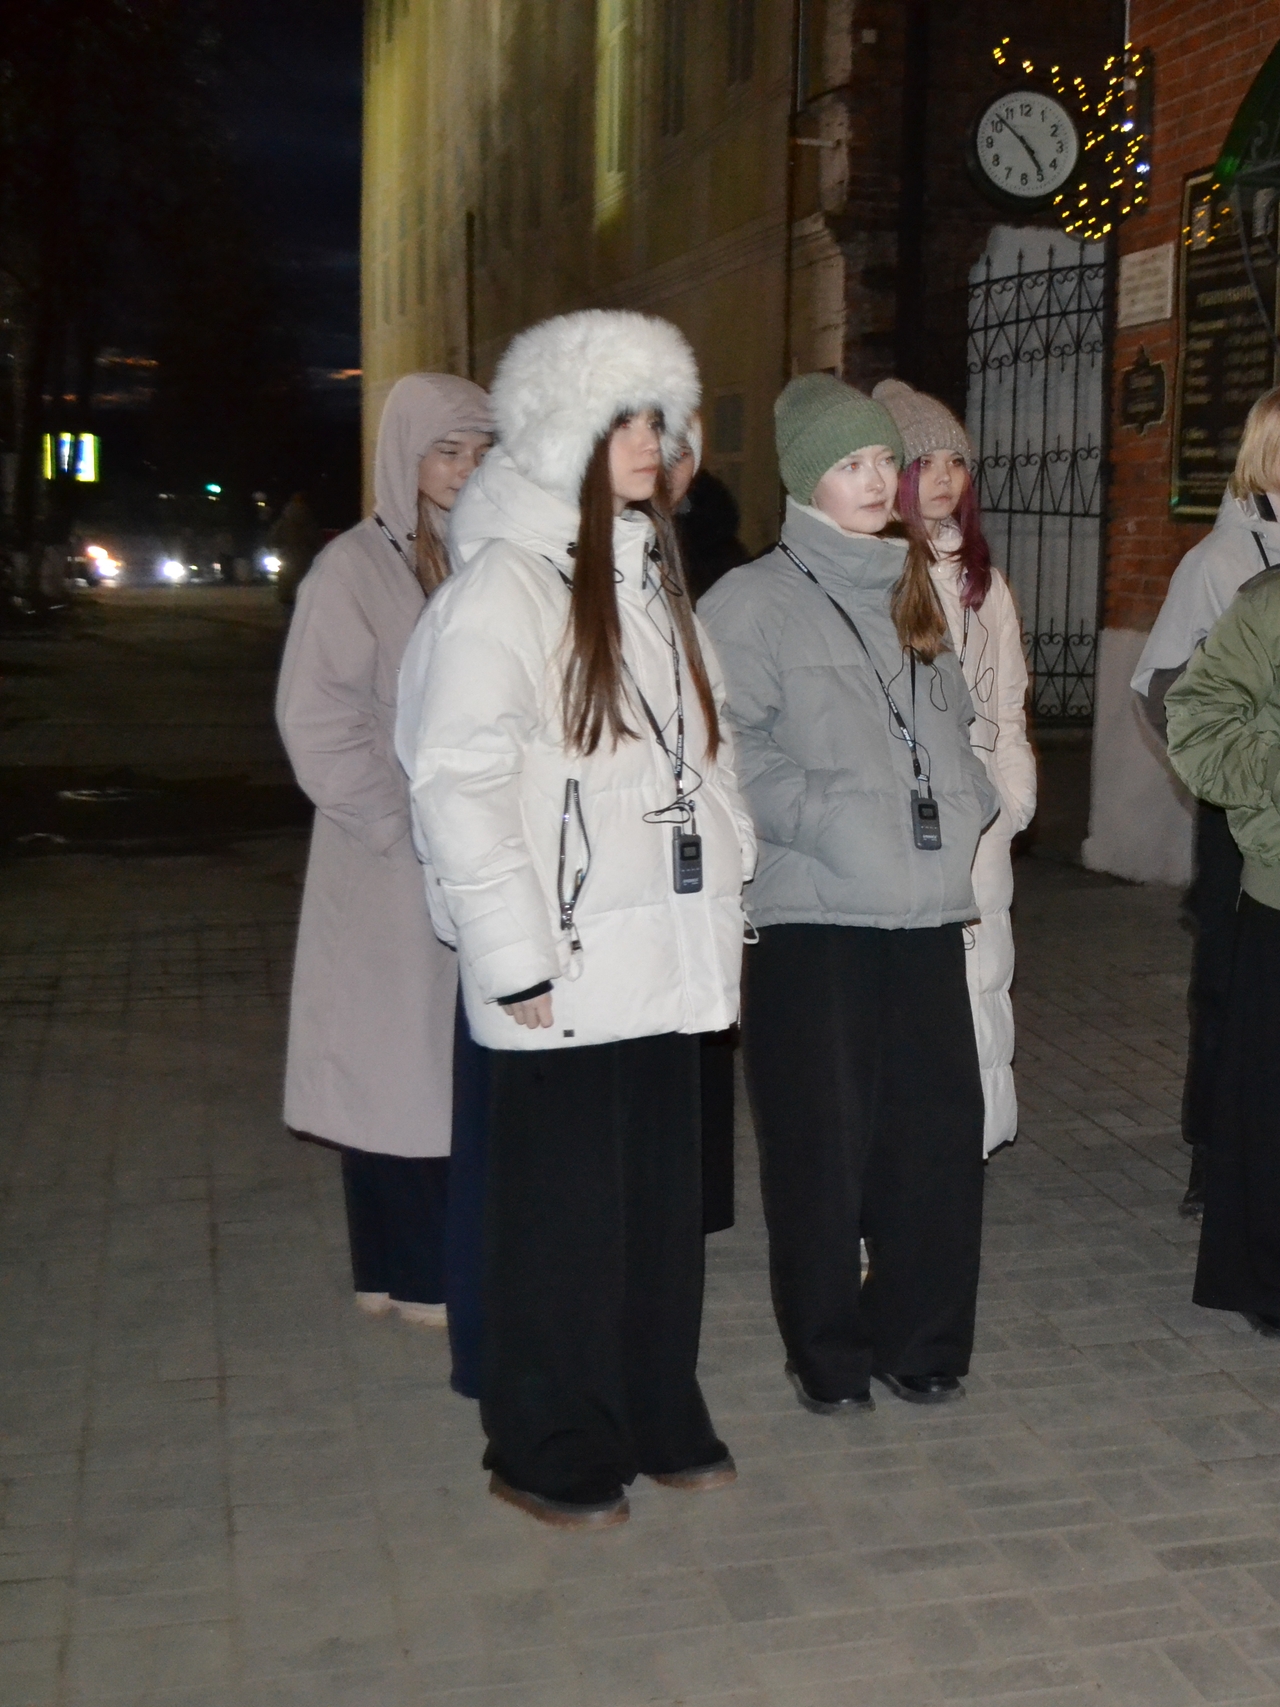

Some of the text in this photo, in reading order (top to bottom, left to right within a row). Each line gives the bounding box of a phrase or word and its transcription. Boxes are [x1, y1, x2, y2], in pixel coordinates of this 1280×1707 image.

[1005, 107, 1014, 120] 11
[1020, 104, 1032, 117] 12
[1041, 110, 1045, 122] 1
[991, 120, 1003, 133] 10
[1050, 124, 1058, 137] 2
[986, 136, 994, 148] 9
[1056, 141, 1064, 154] 3
[992, 154, 1000, 167] 8
[1049, 158, 1057, 170] 4
[1004, 166, 1012, 180] 7
[1020, 173, 1028, 186] 6
[1037, 170, 1044, 182] 5
